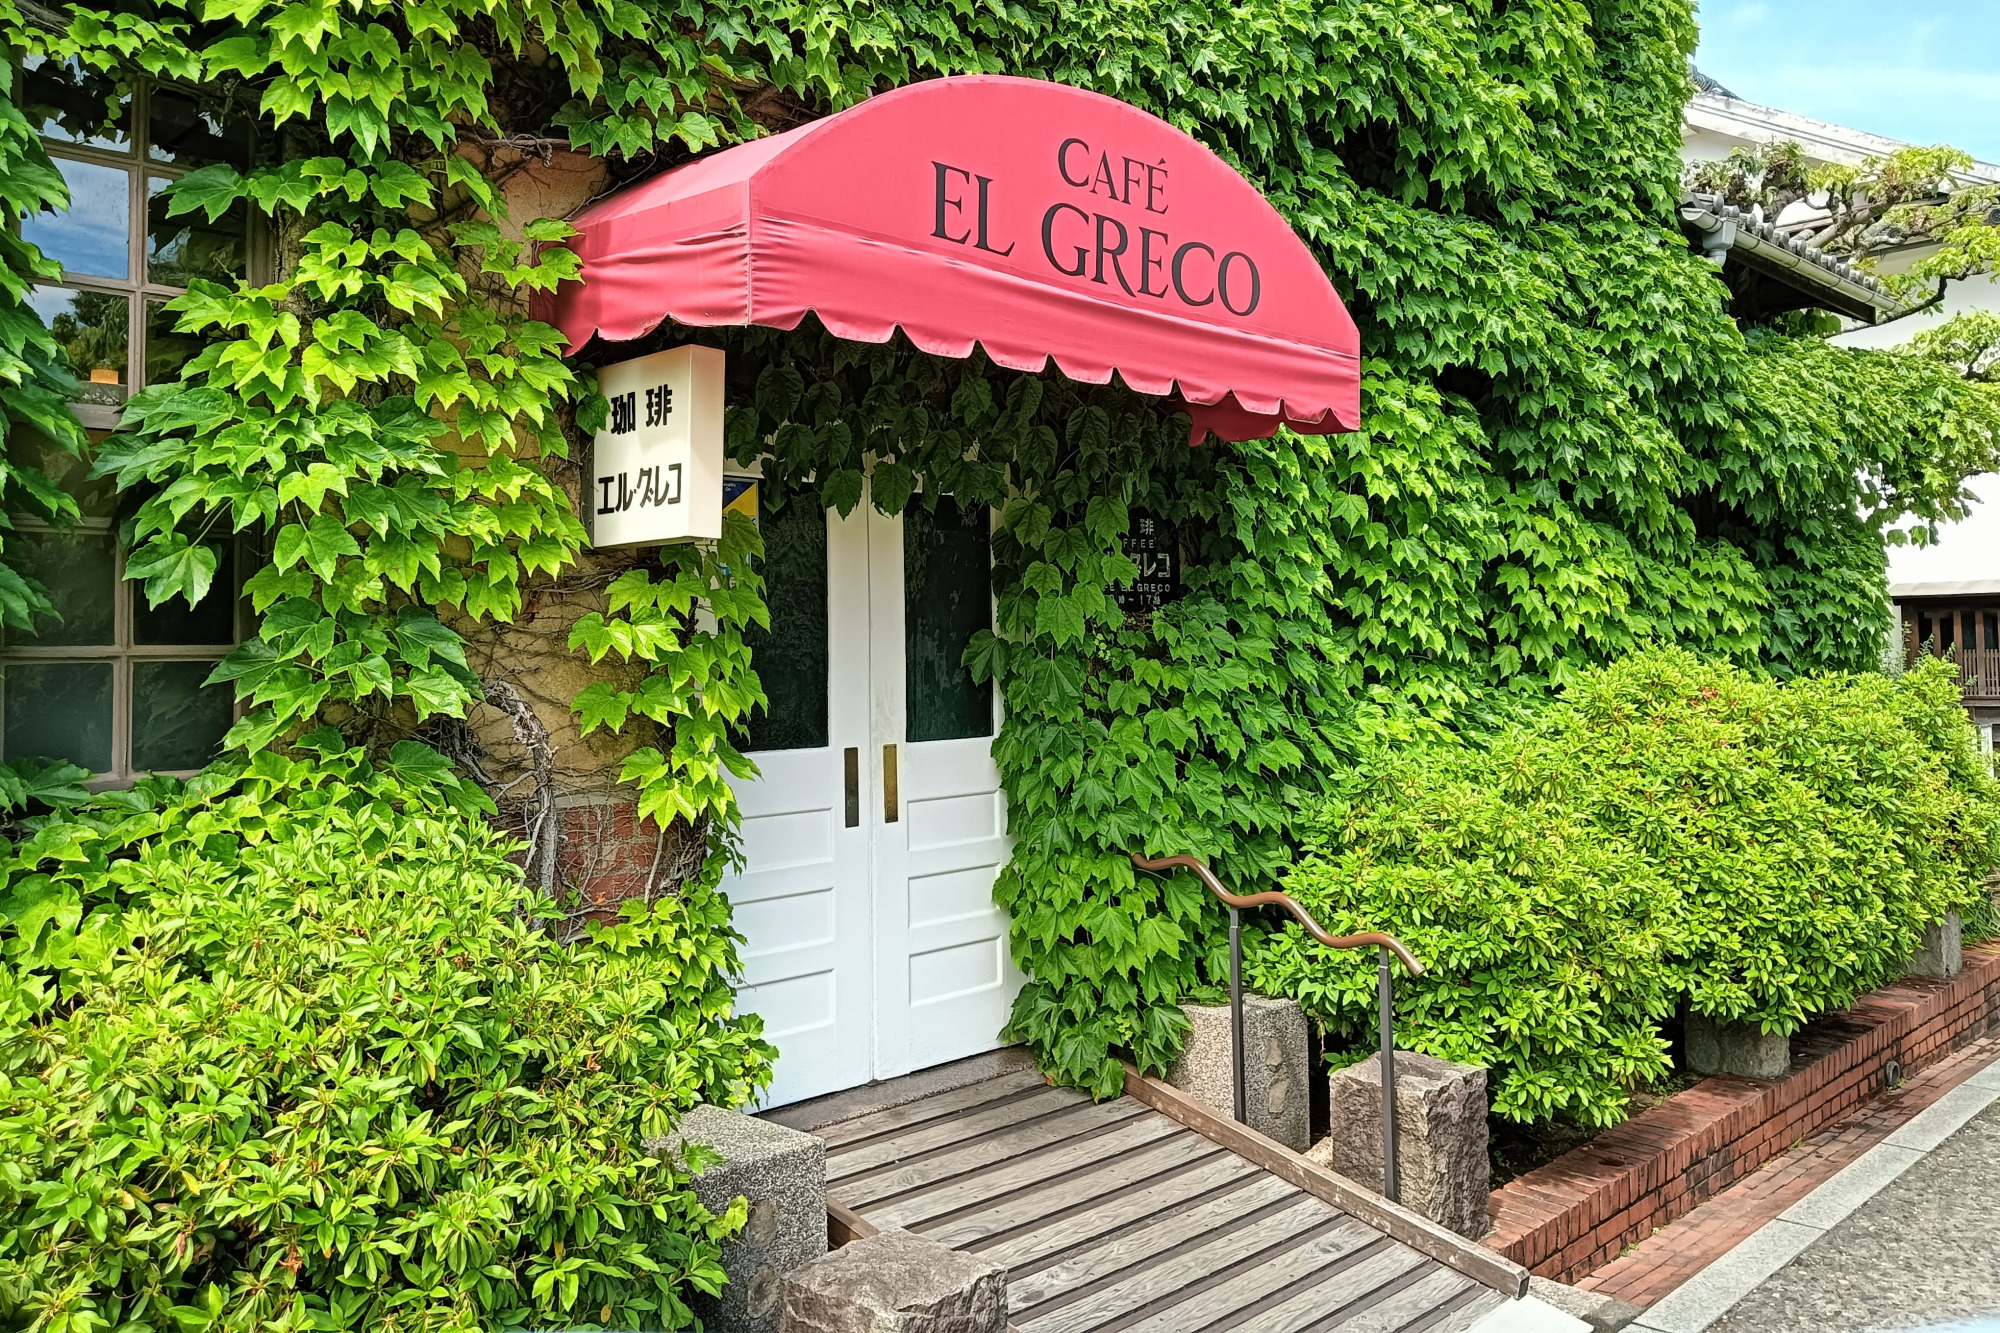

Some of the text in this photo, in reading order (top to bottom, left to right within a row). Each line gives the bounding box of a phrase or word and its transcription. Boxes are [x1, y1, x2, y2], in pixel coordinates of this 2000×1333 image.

[1057, 137, 1169, 215] CAFÉ
[930, 160, 1261, 317] EL GRECO
[610, 383, 673, 436] 珈琲
[1123, 538, 1155, 549] FFEE
[1139, 518, 1154, 536] 琲
[1136, 582, 1171, 593] GRECO
